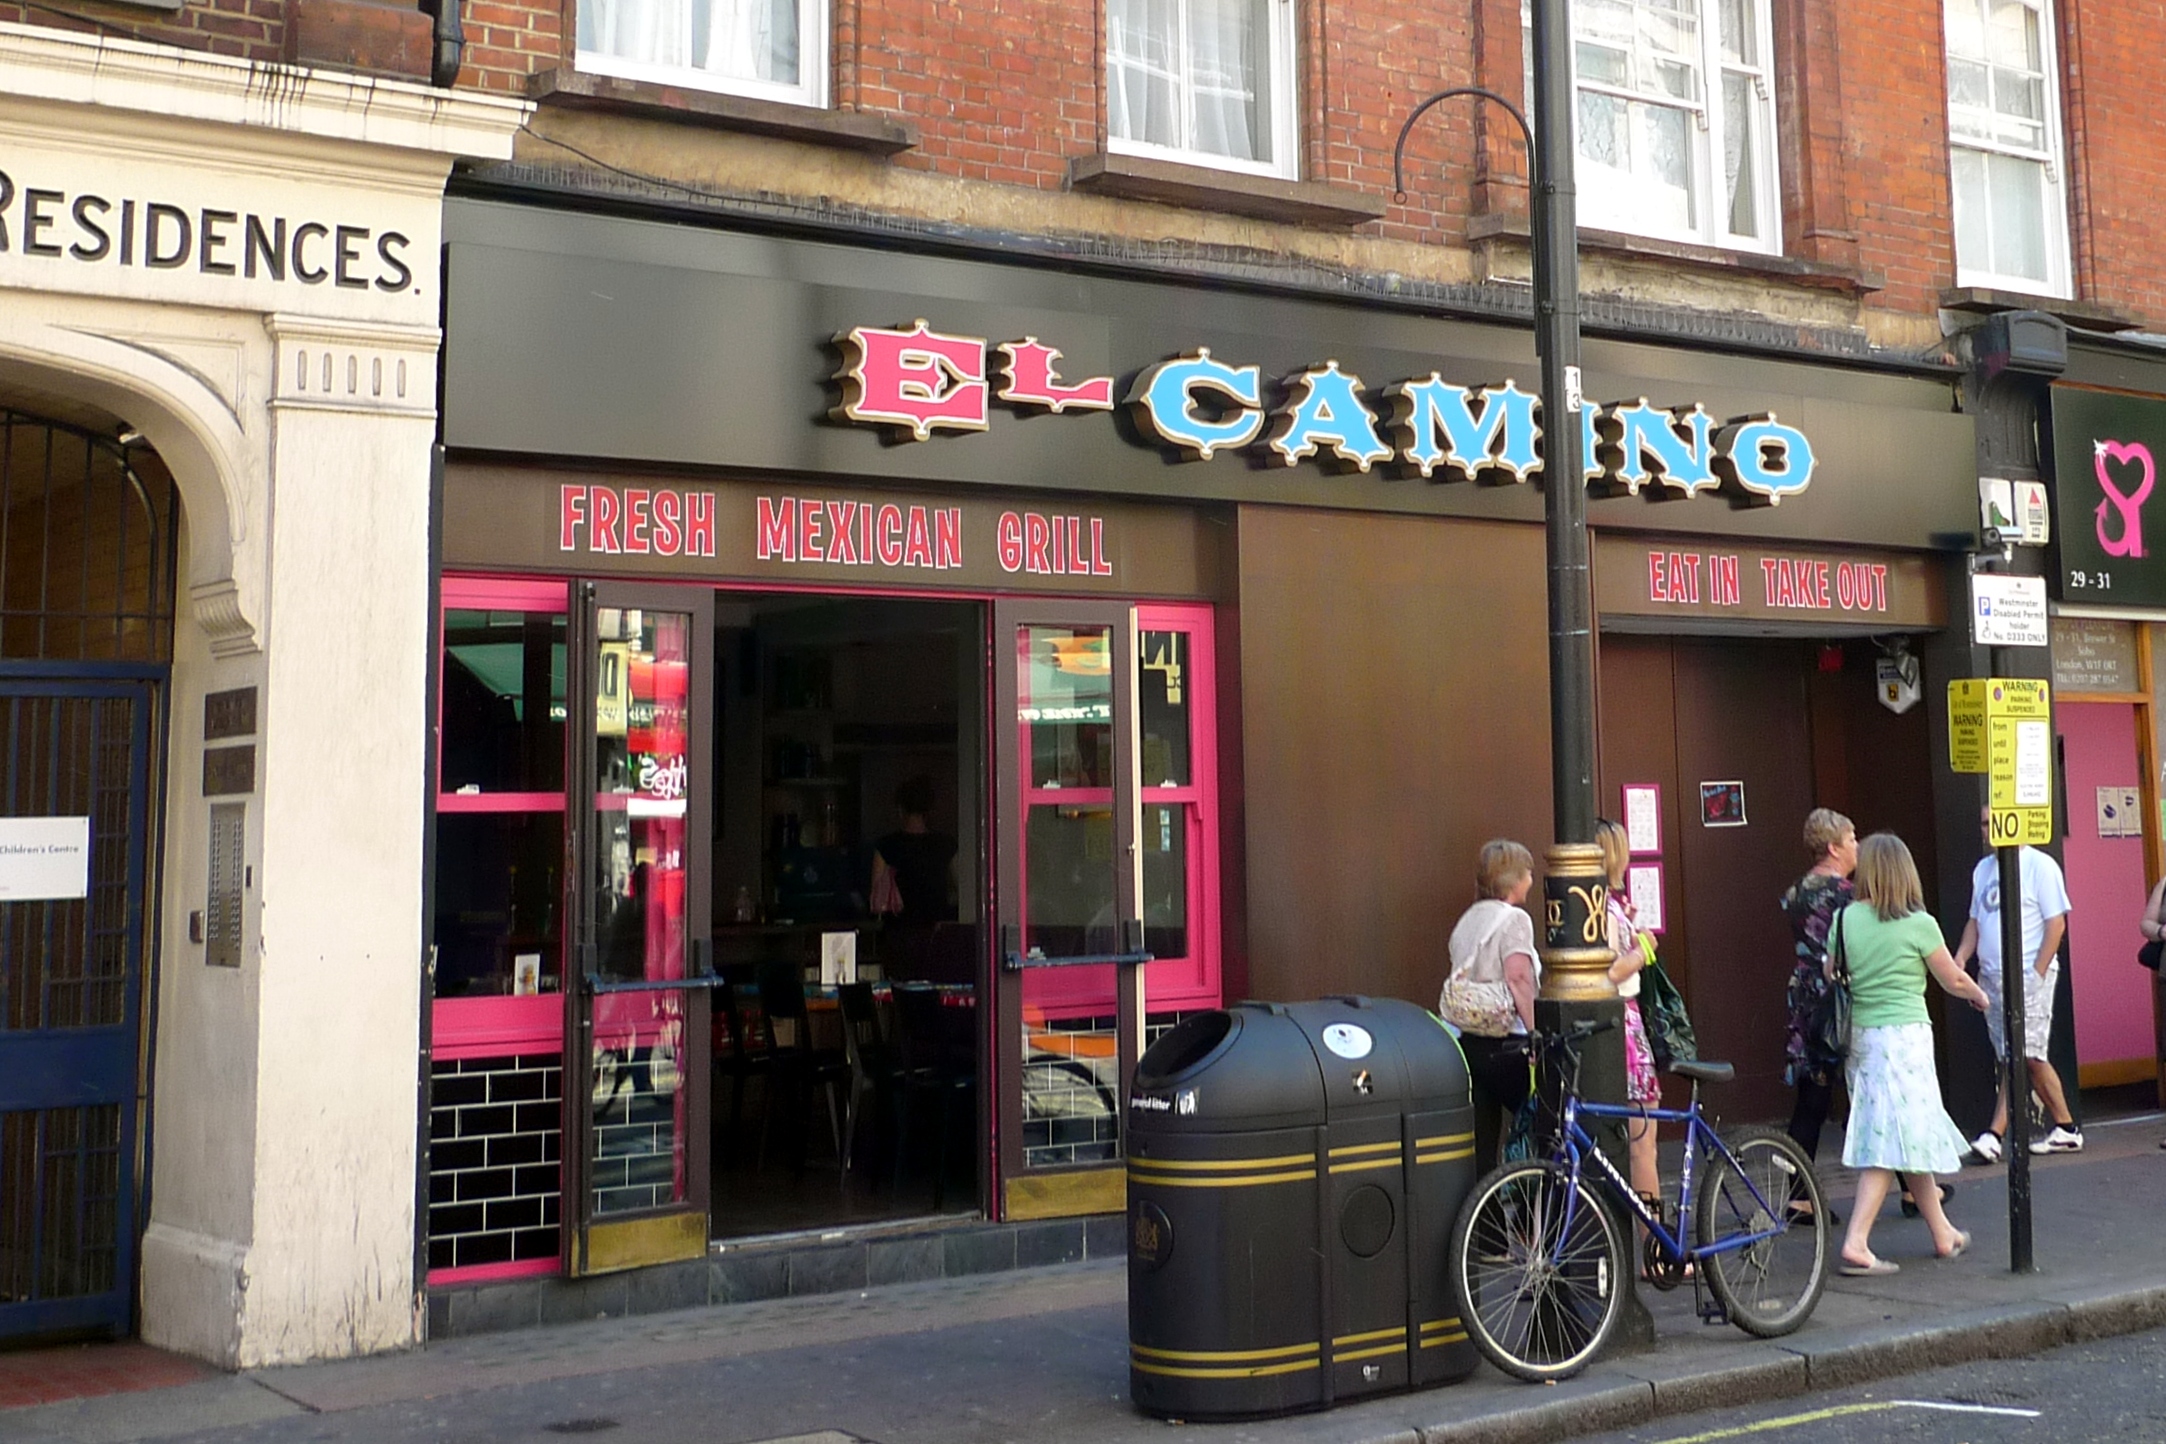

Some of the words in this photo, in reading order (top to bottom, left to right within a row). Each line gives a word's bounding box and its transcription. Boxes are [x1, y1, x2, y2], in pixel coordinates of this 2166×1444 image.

[834, 318, 1115, 441] EL
[560, 484, 716, 557] FRESH
[756, 496, 962, 569] MEXICAN
[997, 511, 1113, 576] GRILL
[1649, 552, 1700, 603] EAT
[1709, 555, 1740, 605] IN
[1760, 558, 1831, 608] TAKE
[1837, 561, 1887, 612] OUT
[2070, 570, 2086, 588] 29
[2097, 572, 2111, 589] 31
[1999, 598, 2038, 608] Westminster
[1994, 609, 2021, 618] Disabled
[2024, 610, 2044, 619] Permit
[2009, 621, 2030, 629] holder
[2027, 633, 2045, 643] ONLY
[2002, 681, 2038, 693] WARNING
[2006, 705, 2036, 714] SUSPENDED
[1953, 713, 1983, 727] WARNING
[1993, 722, 2008, 730] from
[1993, 739, 2007, 748] until
[1993, 756, 2009, 766] place
[2028, 810, 2046, 819] Parking
[1992, 812, 2019, 840] NO
[48, 844, 79, 854] Centre
